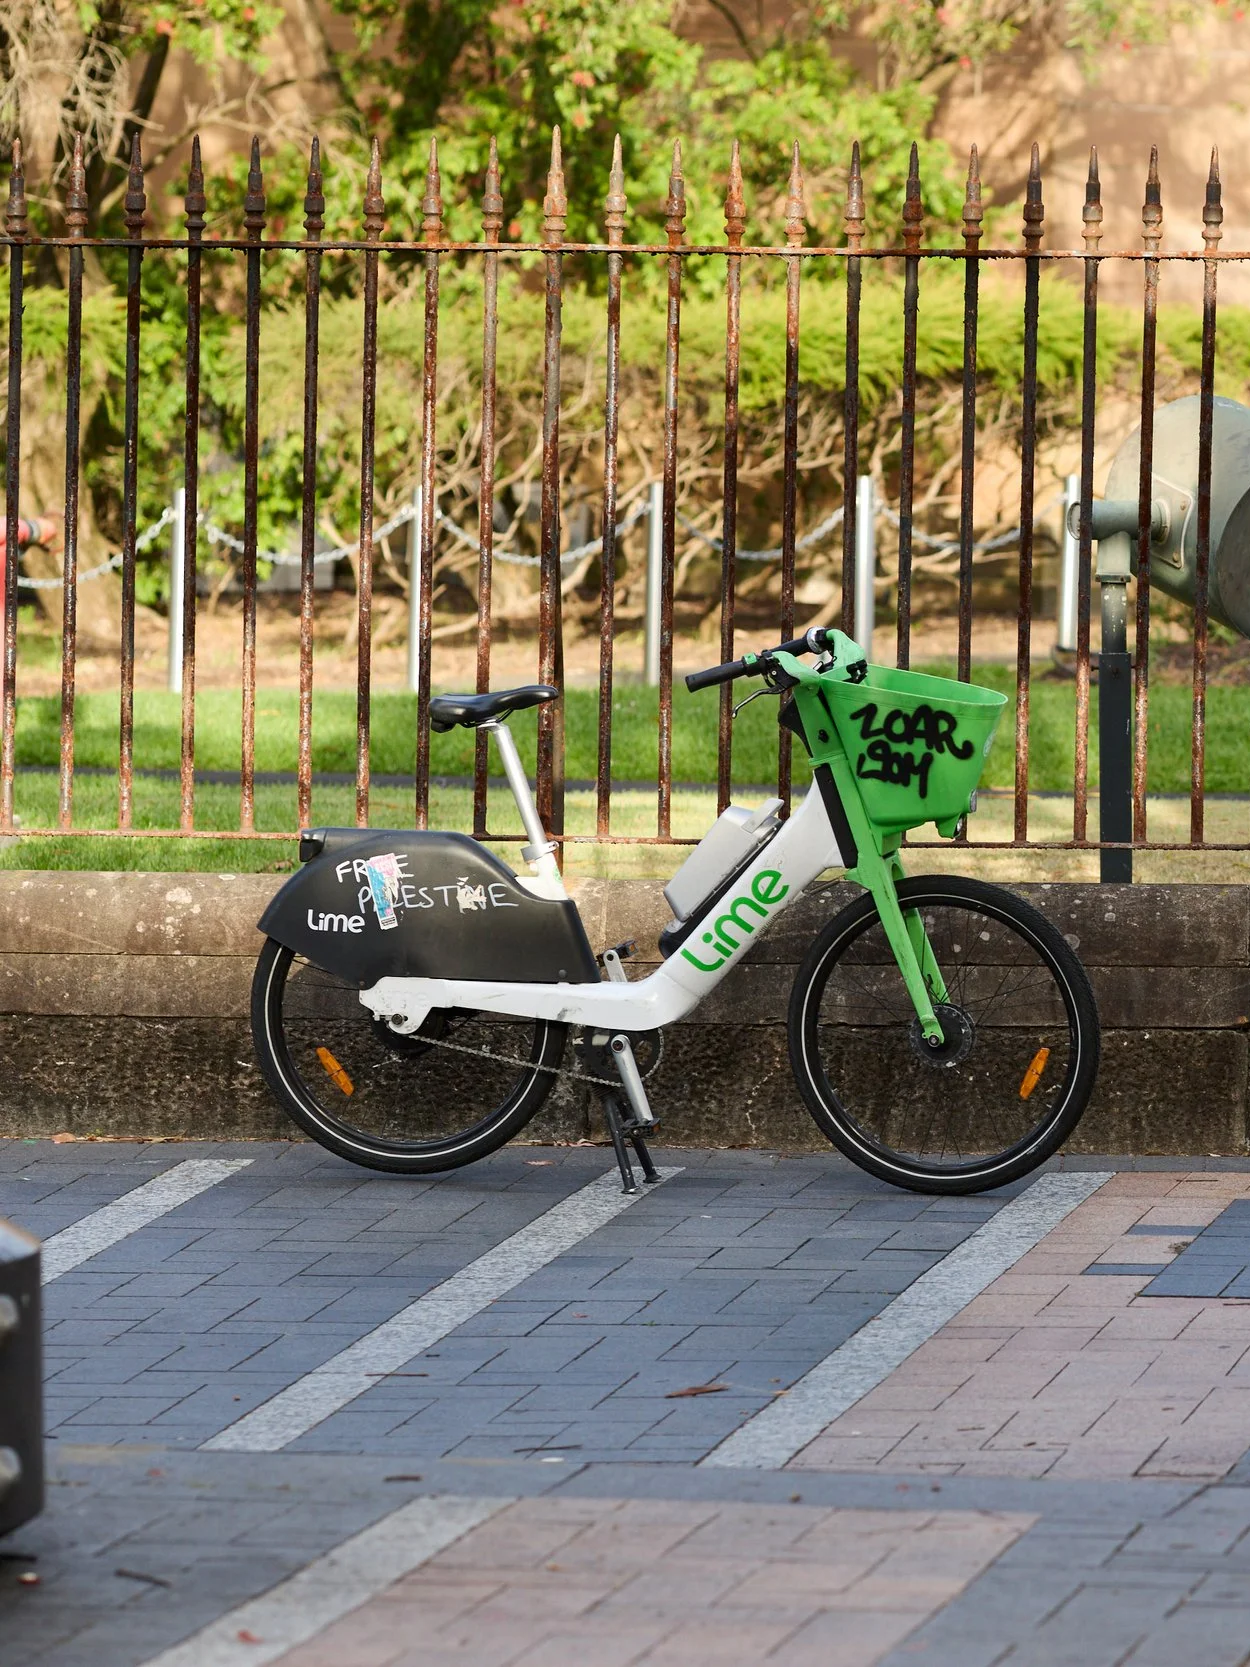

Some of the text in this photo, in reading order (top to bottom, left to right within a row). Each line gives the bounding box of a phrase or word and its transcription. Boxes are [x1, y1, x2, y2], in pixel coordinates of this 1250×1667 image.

[336, 854, 414, 883] FRE
[358, 883, 519, 914] PESTNE
[307, 909, 365, 933] Lime
[681, 869, 789, 972] Lime
